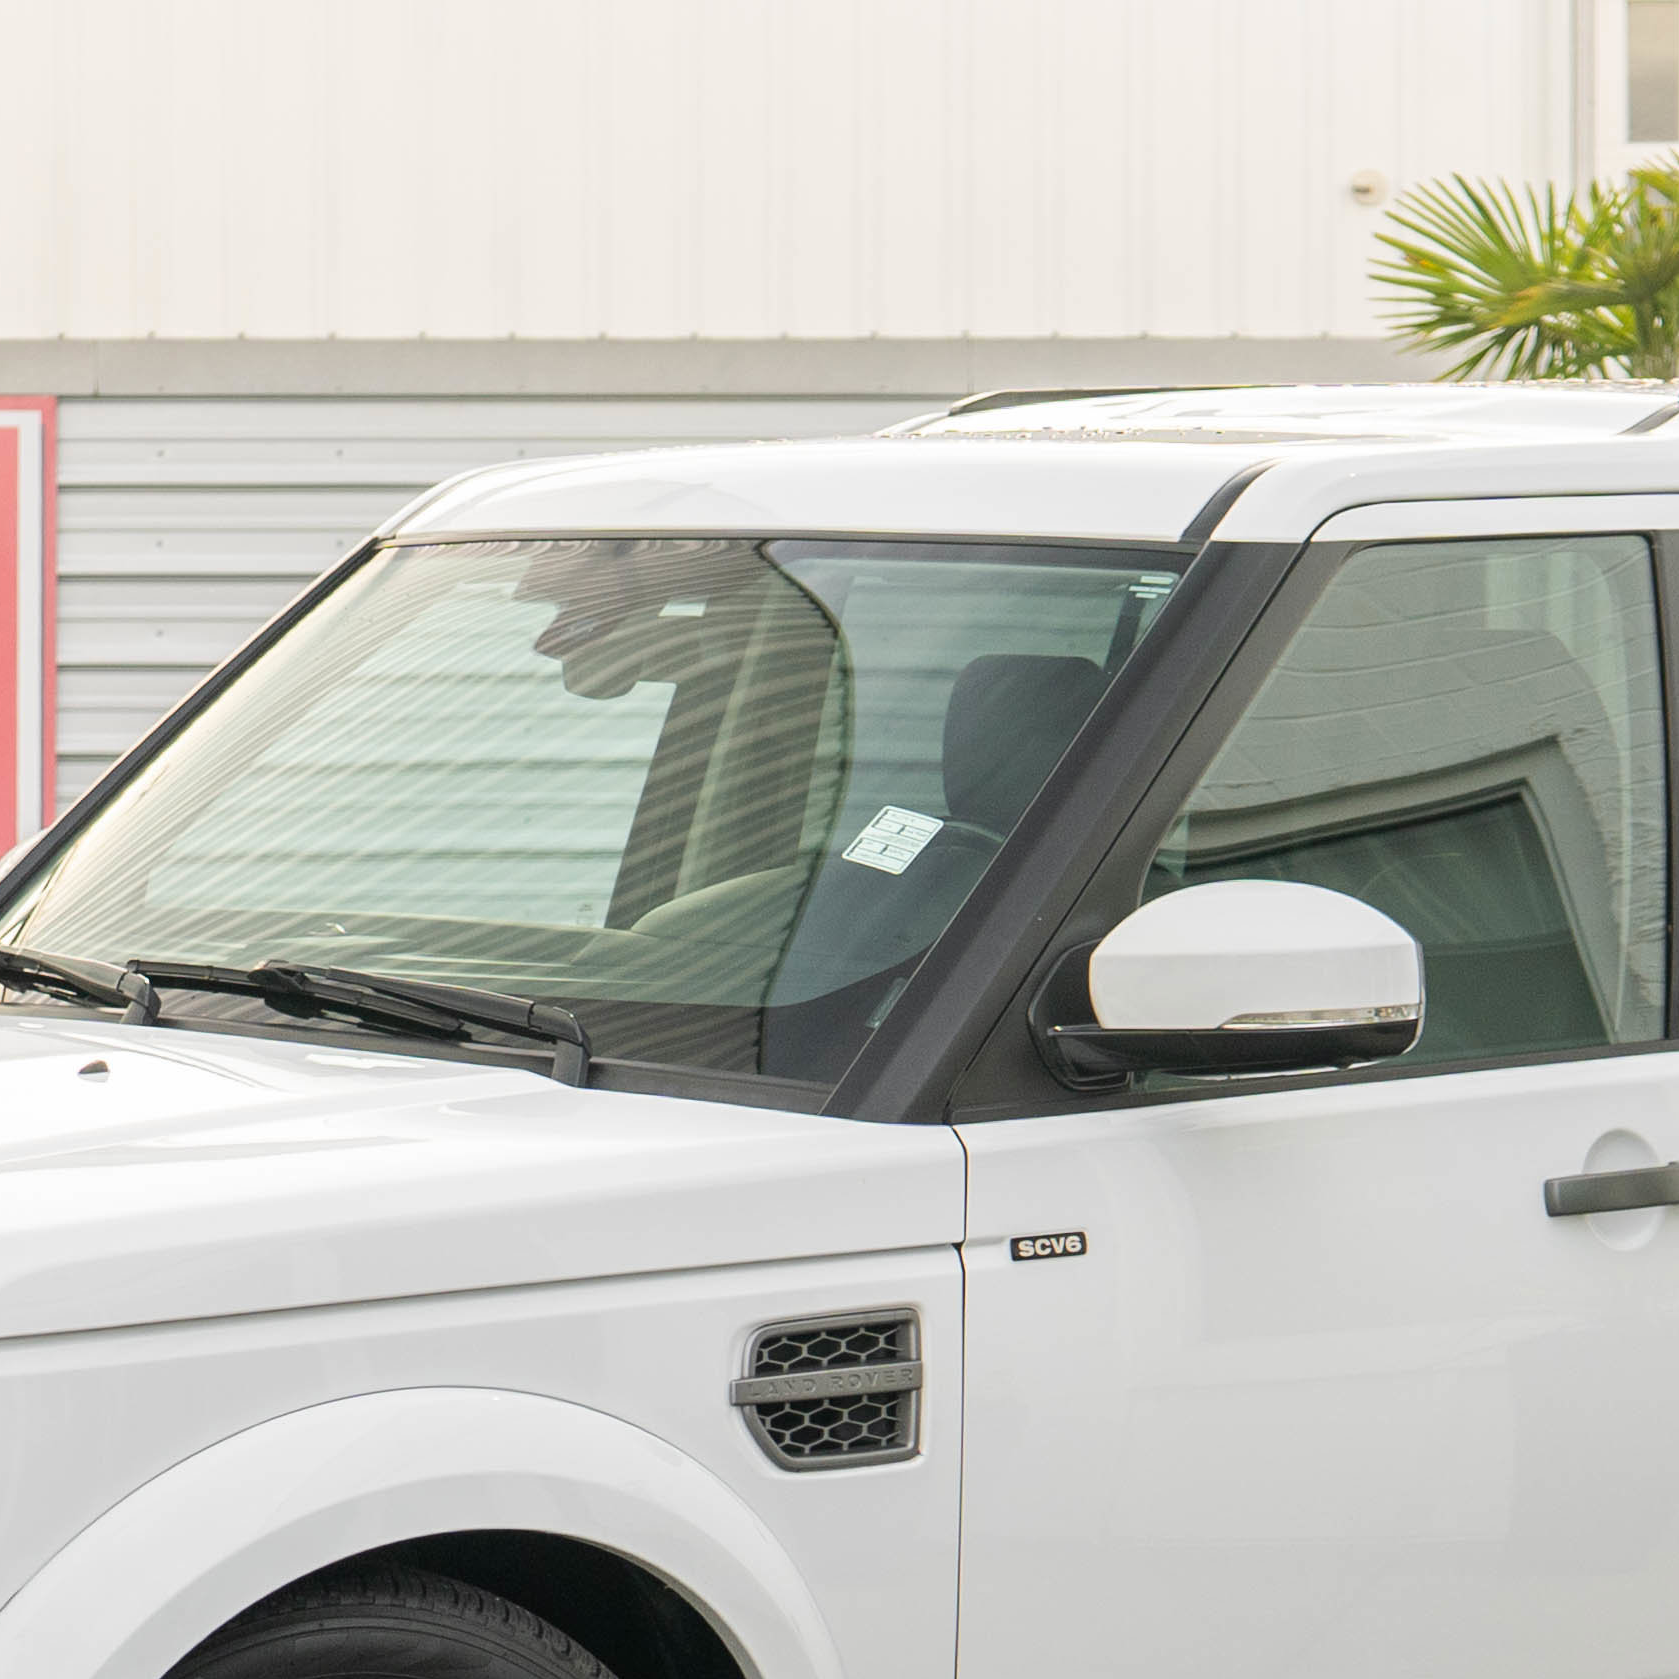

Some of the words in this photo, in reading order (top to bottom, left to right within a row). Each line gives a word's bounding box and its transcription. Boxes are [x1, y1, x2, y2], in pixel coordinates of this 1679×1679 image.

[1017, 1235, 1082, 1258] SCV6
[747, 1378, 817, 1399] LAND
[830, 1368, 914, 1392] ROVER
